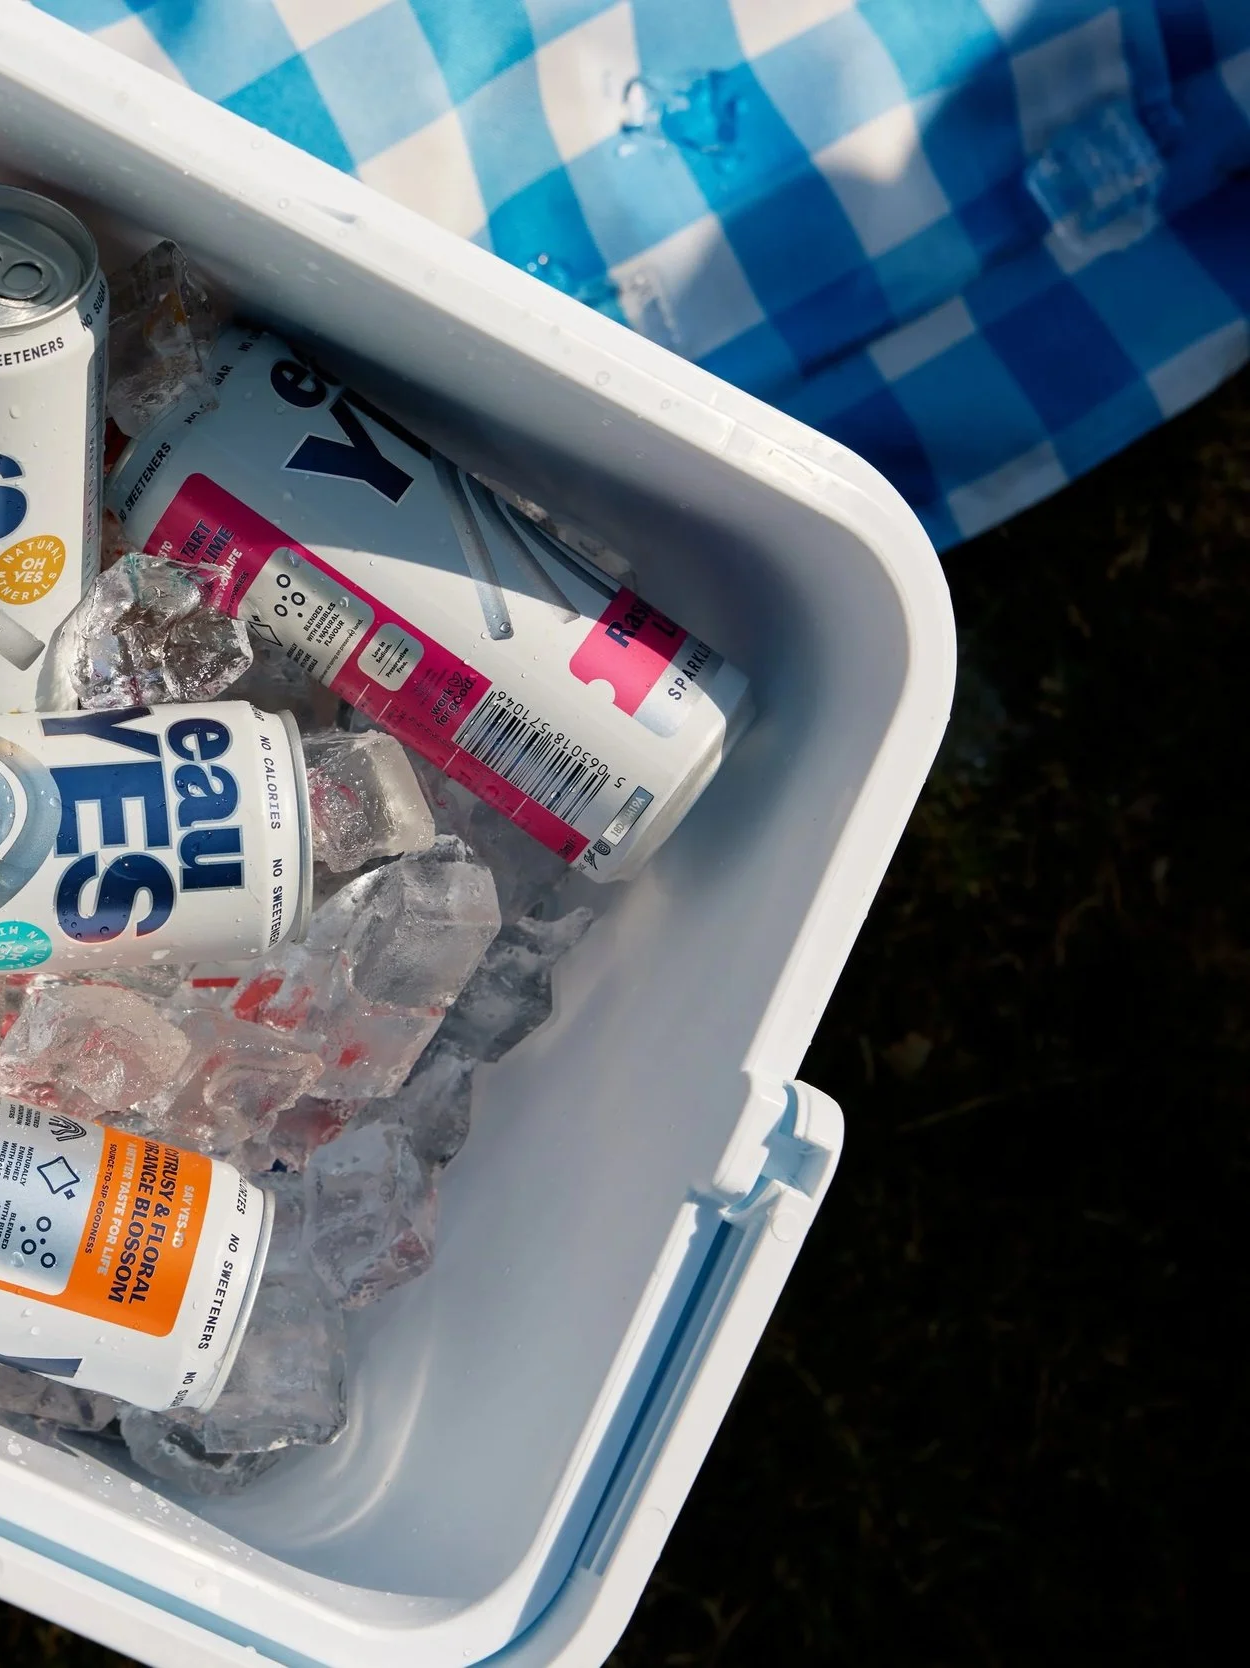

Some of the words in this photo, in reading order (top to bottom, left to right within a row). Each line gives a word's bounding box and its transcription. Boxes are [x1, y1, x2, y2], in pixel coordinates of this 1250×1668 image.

[80, 313, 93, 332] NO
[125, 442, 171, 512] SWEETENERS
[3, 540, 62, 564] NATURAL
[180, 519, 211, 560] TART
[14, 570, 44, 584] YES
[21, 557, 47, 570] OH
[303, 605, 324, 632] BLENDED
[306, 626, 319, 643] WITH
[316, 602, 336, 630] BUBBLES
[320, 612, 341, 639] NATURAL
[323, 619, 346, 647] FLAVOUR
[372, 647, 382, 659] Low
[379, 641, 386, 649] in
[375, 643, 393, 664] Sodium.
[385, 647, 409, 678] Preservative
[396, 660, 408, 674] Free.
[431, 687, 454, 717] work
[435, 712, 450, 727] for
[449, 676, 477, 715] good.
[498, 691, 550, 735] 571046
[259, 735, 272, 751] NO
[554, 732, 609, 776] 065018
[263, 757, 281, 830] CALORIES
[614, 777, 627, 789] 5
[165, 717, 246, 893] eau
[39, 706, 178, 944] YES
[272, 858, 283, 878] NO
[6, 944, 29, 961] OH
[6, 1103, 17, 1119] LAYERS
[6, 1141, 17, 1160] WITH
[10, 1144, 25, 1181] ENRICHED
[1, 1159, 13, 1180] PURE
[17, 1145, 34, 1186] NATURALLY
[96, 1142, 120, 1198] SOURCE-TO-SIP
[132, 1140, 165, 1195] ORANGE
[151, 1147, 185, 1202] CITRUSY
[111, 1179, 132, 1216] TASTE
[179, 1183, 195, 1205] SAY
[0, 1198, 11, 1221] WITH
[152, 1201, 172, 1220] &
[0, 1211, 17, 1250] BLENDED
[83, 1199, 105, 1255] GOODNESS
[104, 1216, 122, 1245] FOR
[107, 1195, 152, 1304] BLOSSOM
[228, 1233, 240, 1253] NO
[95, 1245, 114, 1276] LIFE
[127, 1220, 167, 1308] FLORAL
[198, 1260, 234, 1350] SWEETENERS
[182, 1371, 197, 1385] NO
